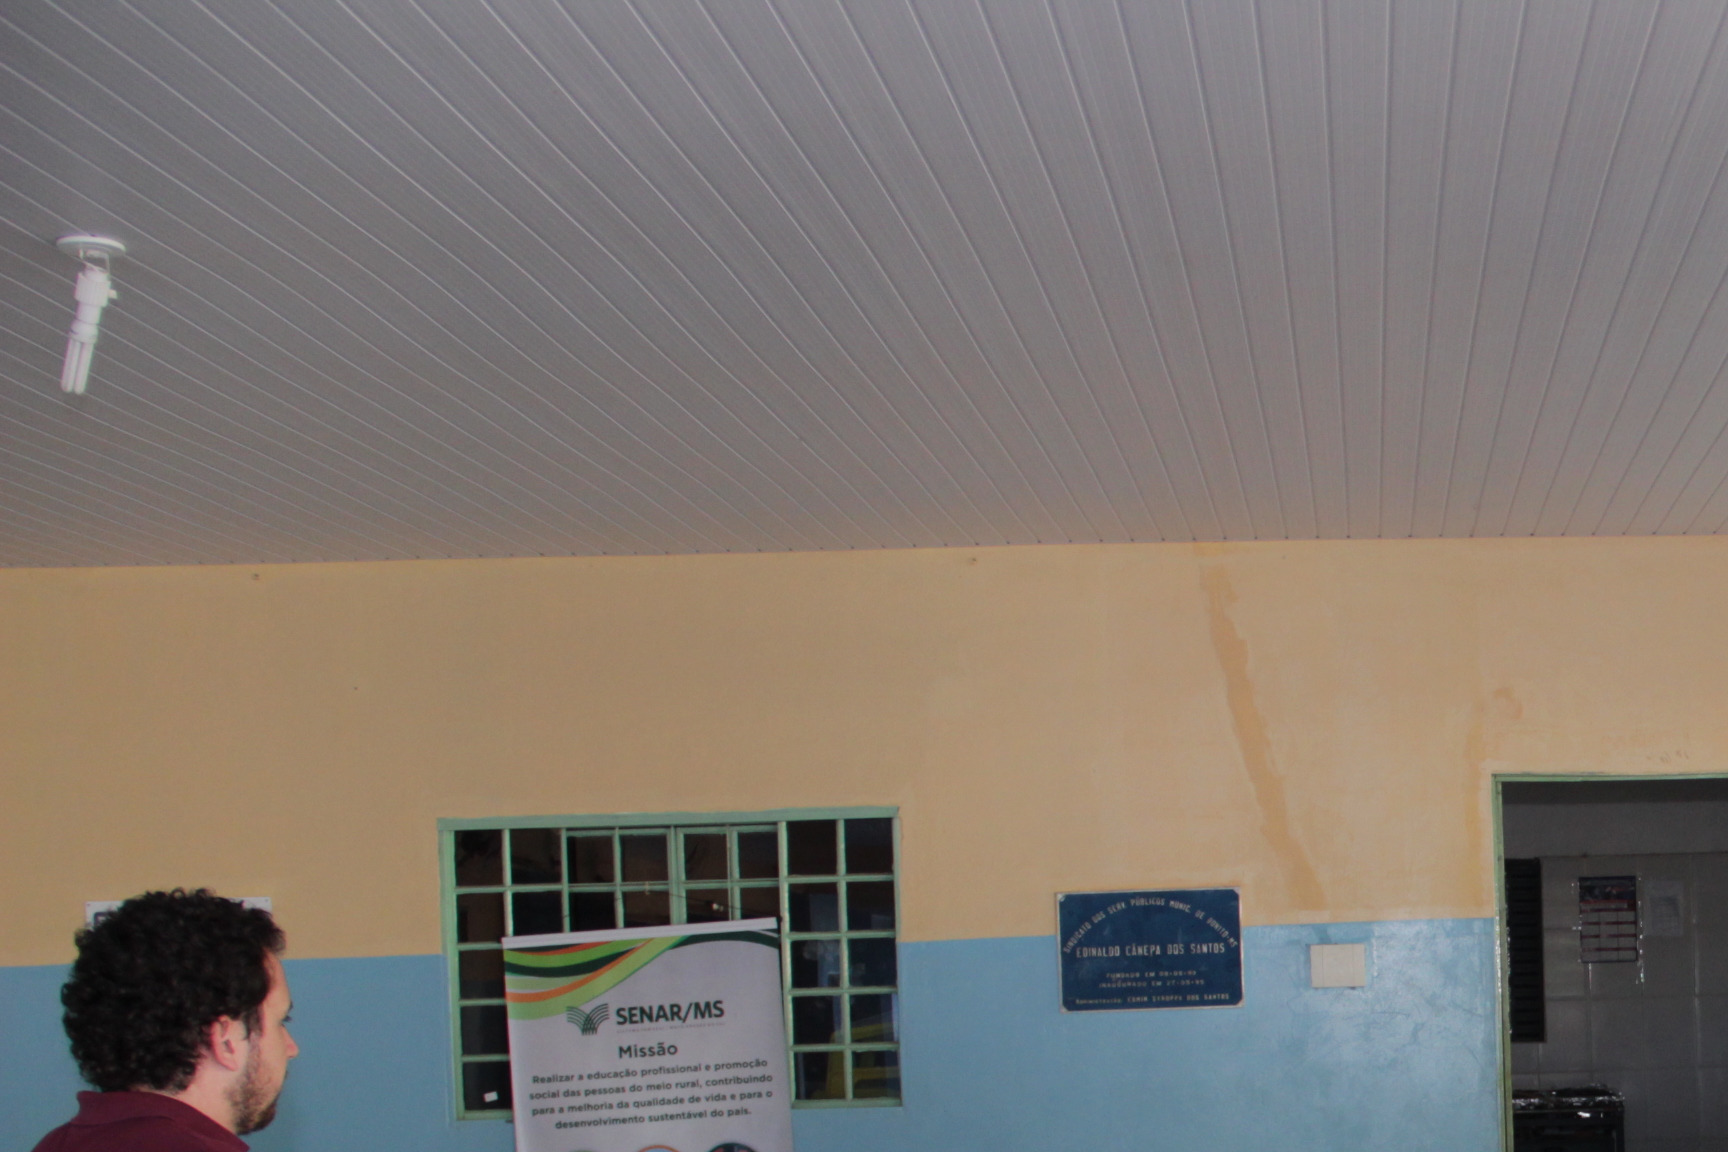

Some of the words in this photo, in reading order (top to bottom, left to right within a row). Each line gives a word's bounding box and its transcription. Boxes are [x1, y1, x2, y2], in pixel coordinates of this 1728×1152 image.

[1062, 921, 1092, 955] SINDICATO
[1167, 944, 1185, 956] DOS
[1190, 942, 1226, 954] SANTOS
[616, 1000, 726, 1026] SENAR/MS
[618, 1041, 679, 1059] Missão
[532, 1074, 575, 1085] Realizar
[577, 1074, 584, 1082] a
[587, 1068, 638, 1081] educação
[641, 1063, 702, 1078] profissional
[704, 1064, 711, 1072] e
[714, 1059, 768, 1074] promoção
[529, 1089, 560, 1100] social
[563, 1087, 582, 1098] das
[584, 1086, 626, 1098] pessoas
[629, 1083, 643, 1092] do
[646, 1081, 672, 1092] meio
[675, 1078, 703, 1090] rural,
[705, 1073, 773, 1088] contribuindo
[531, 1107, 556, 1117] para
[558, 1106, 565, 1114] a
[567, 1101, 614, 1114] melhoria
[616, 1100, 630, 1110] da
[632, 1096, 685, 1109] qualidade
[688, 1094, 702, 1104] de
[704, 1092, 727, 1102] vida
[740, 1090, 763, 1101] para
[766, 1090, 774, 1098] o
[555, 1114, 646, 1130] desenvolvimento
[648, 1110, 708, 1123] sustentável
[710, 1108, 724, 1118] do
